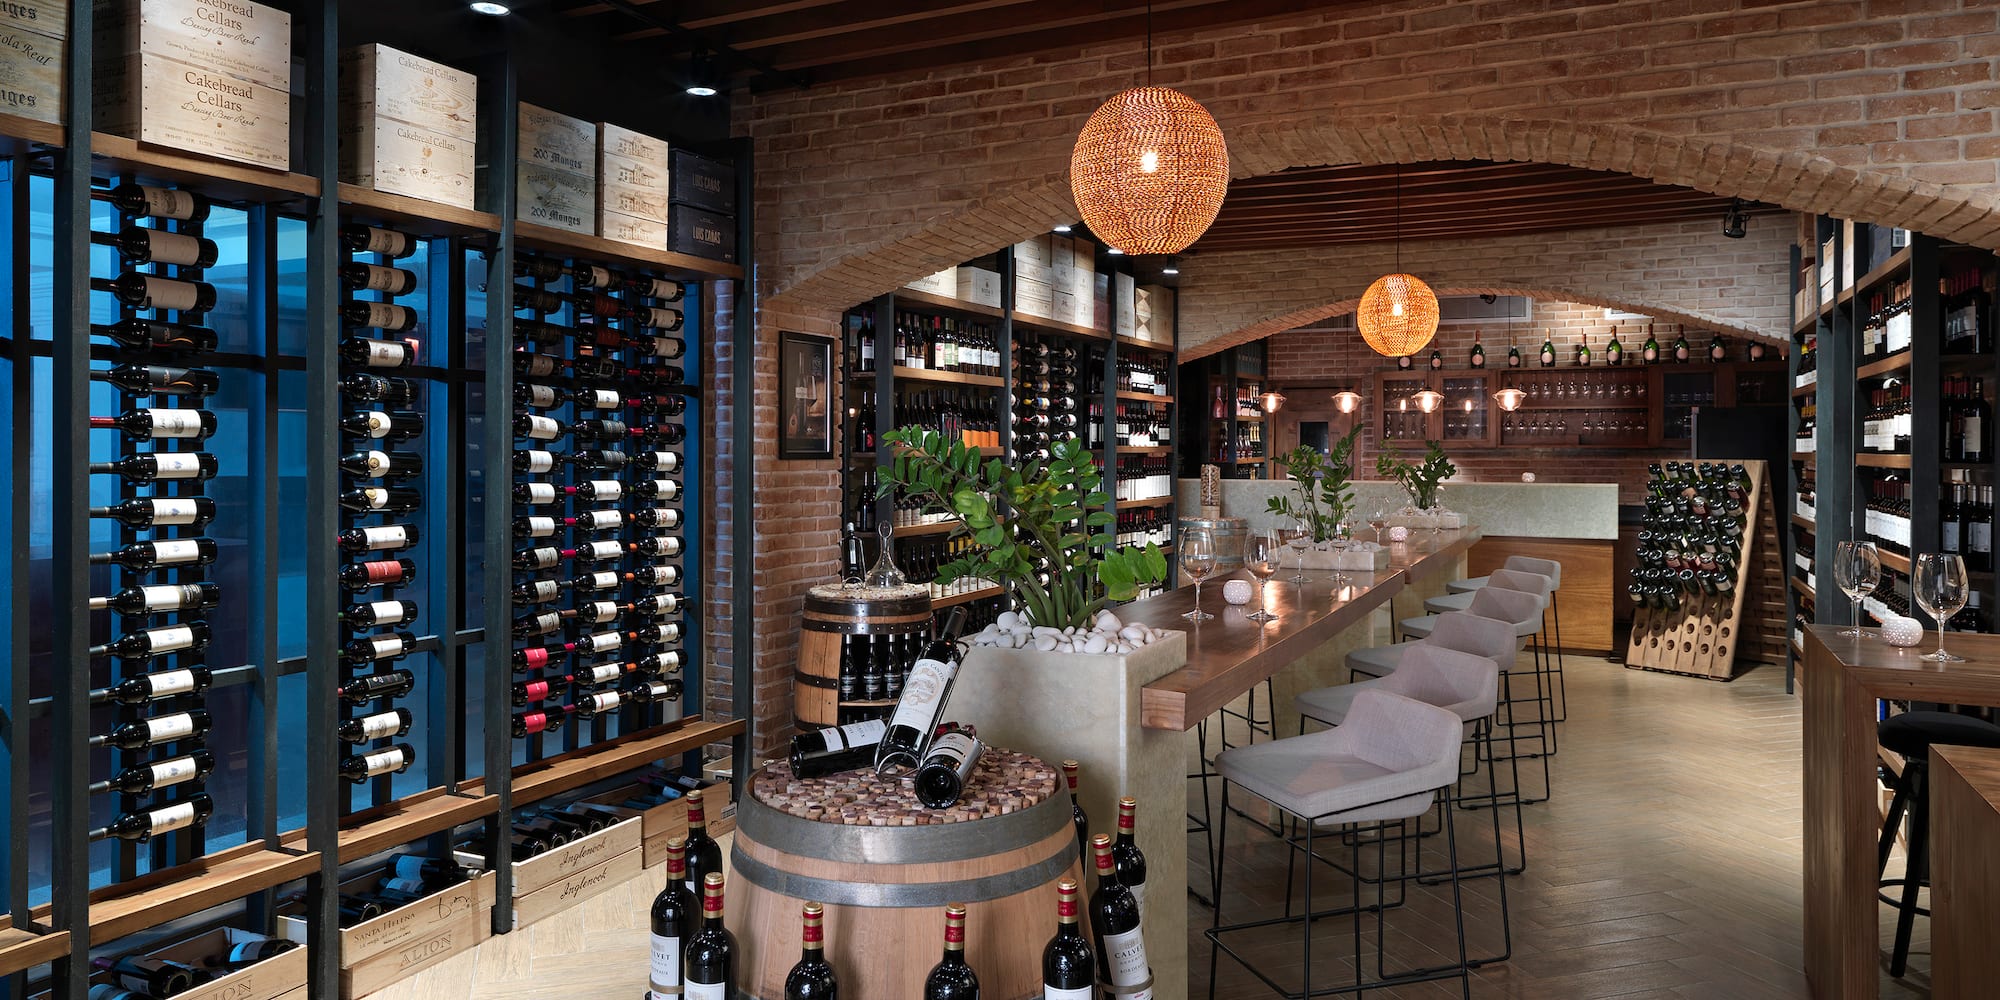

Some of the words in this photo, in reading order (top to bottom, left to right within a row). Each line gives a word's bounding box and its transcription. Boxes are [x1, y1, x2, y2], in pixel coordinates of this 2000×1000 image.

[196, 7, 242, 31] Cellars
[199, 0, 254, 19] kebread
[22, 43, 53, 66] Real
[398, 56, 434, 76] Cakebread
[434, 68, 458, 83] Cellars
[185, 71, 254, 99] Cakebread
[197, 90, 242, 112] Cellars
[397, 127, 433, 145] Cakebread
[433, 137, 456, 151] Cellars
[533, 147, 548, 159] 200
[551, 152, 582, 169] Monges
[531, 206, 546, 217] 200
[549, 210, 581, 226] Monges
[693, 224, 704, 240] LUIS
[559, 836, 607, 868] Inglenook
[560, 867, 608, 900] Inglenook
[400, 933, 452, 967] ALION
